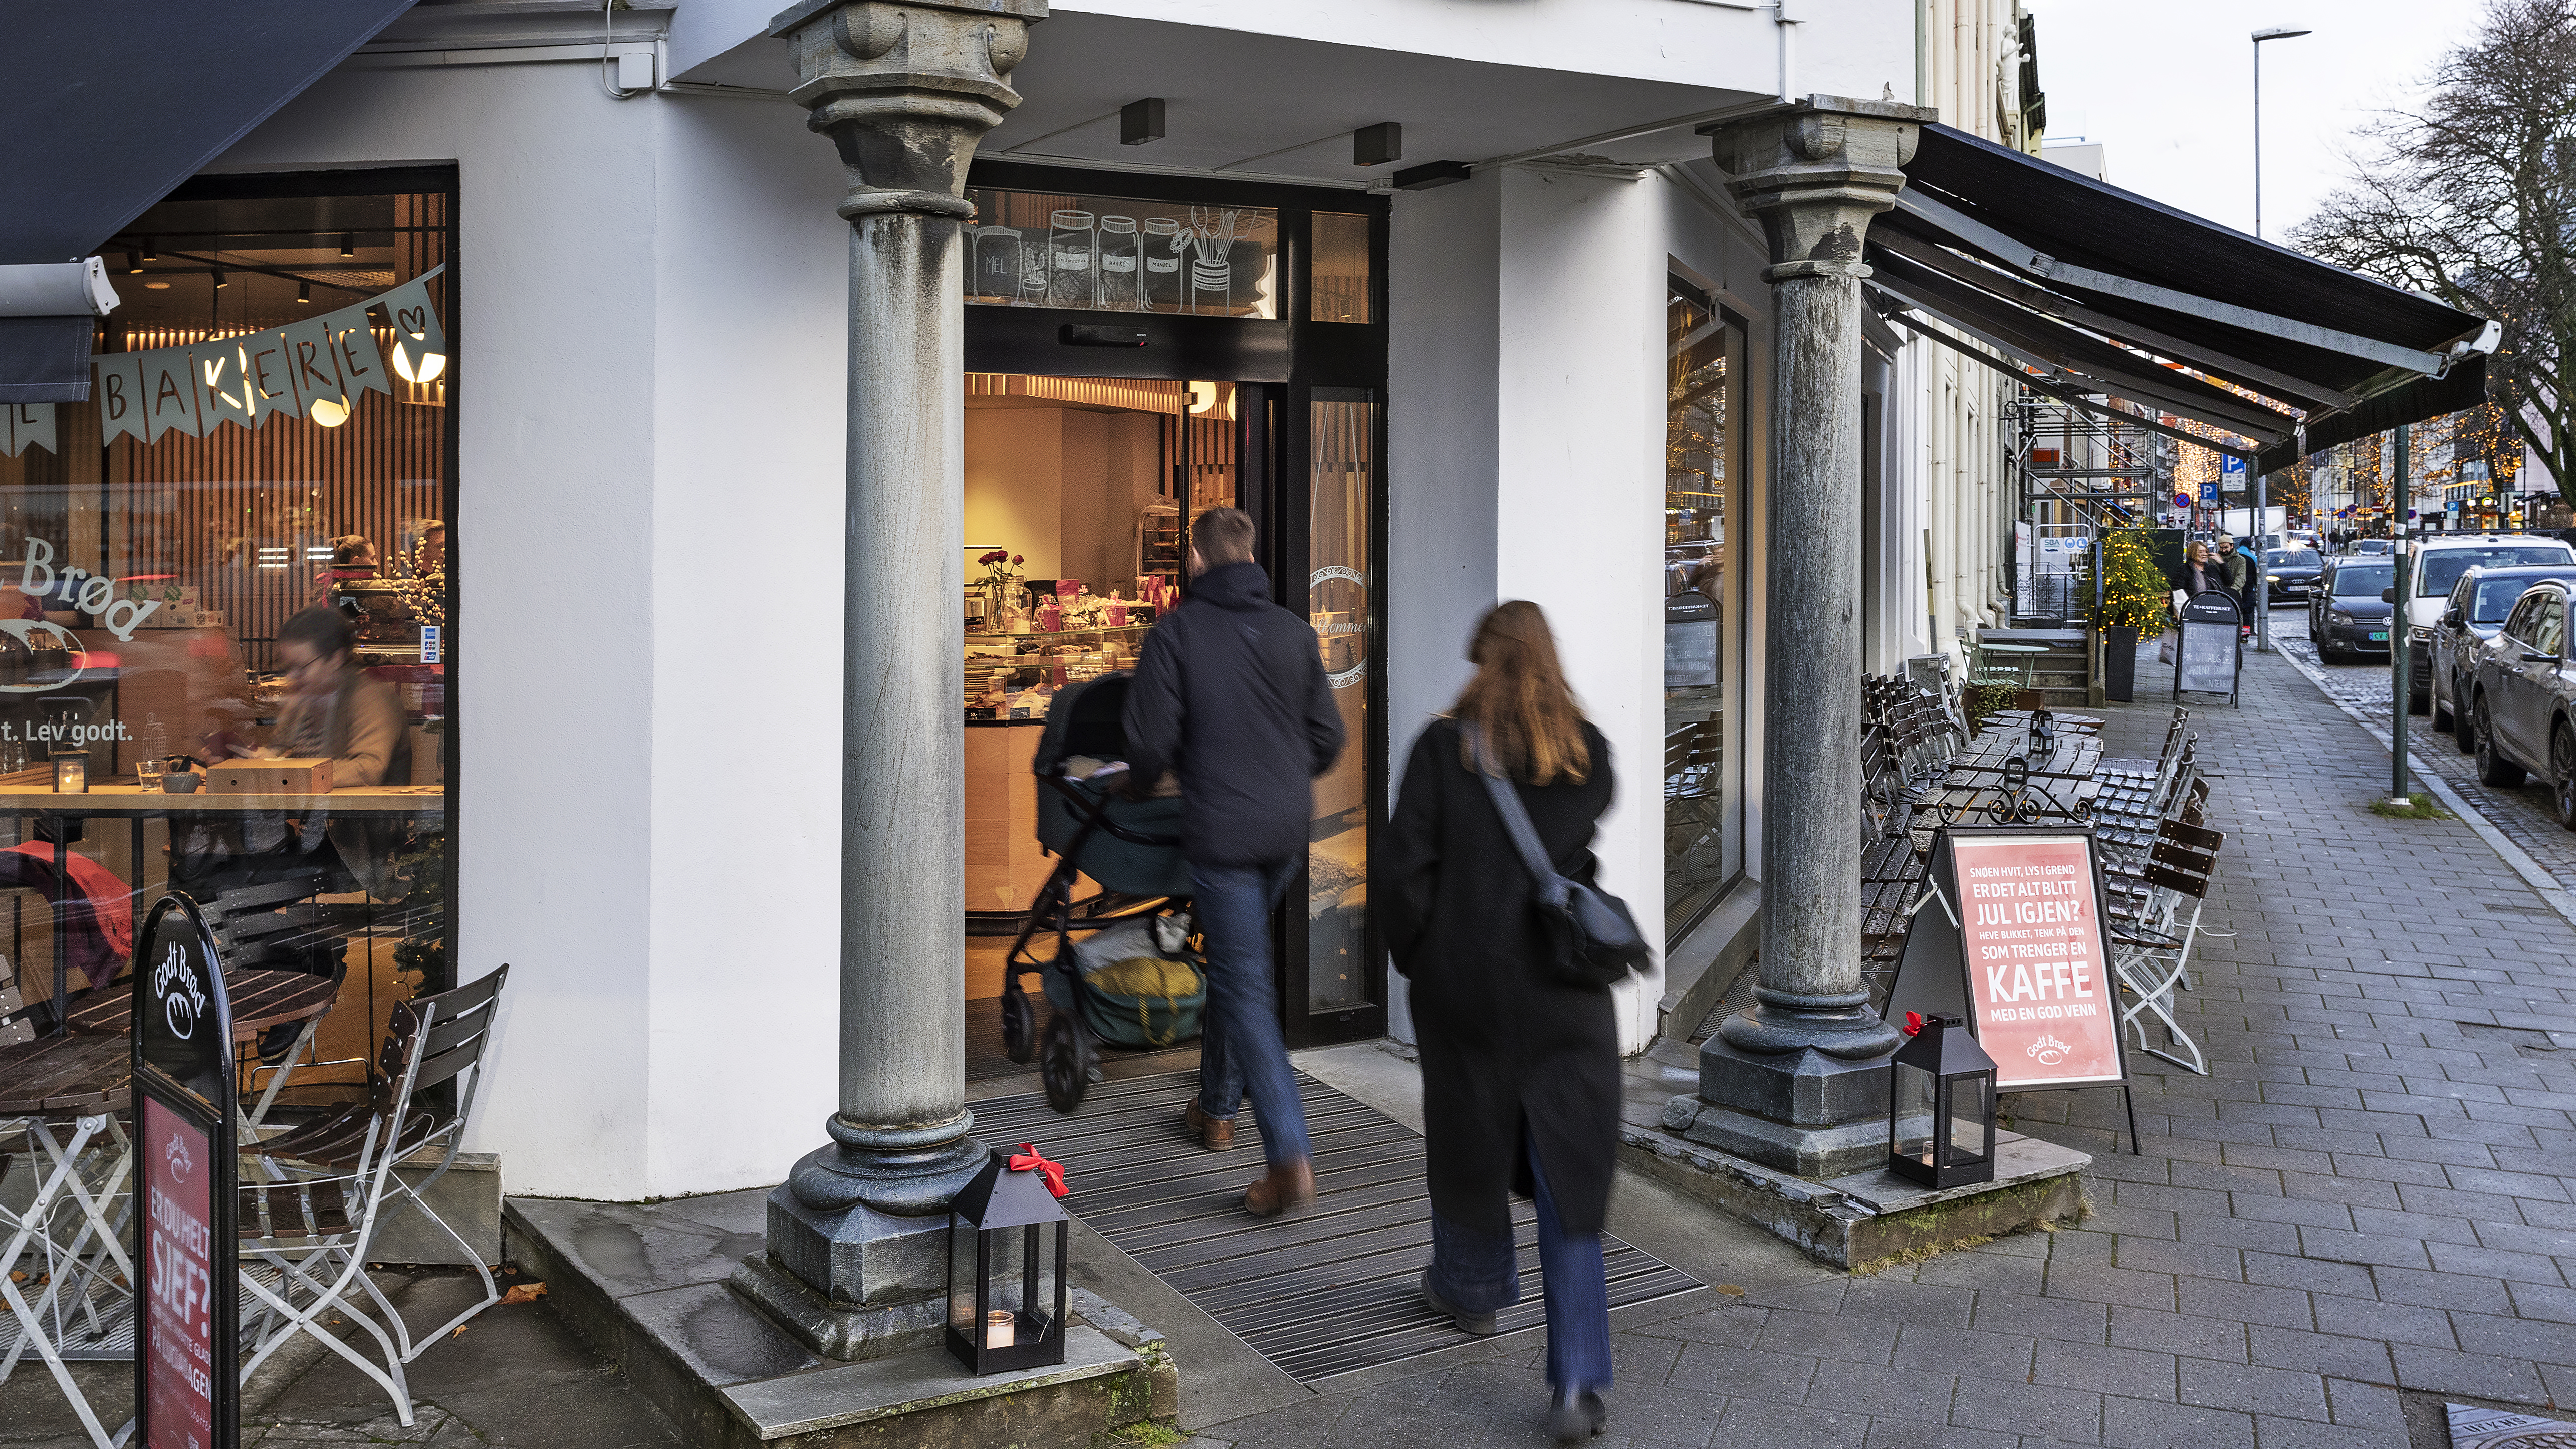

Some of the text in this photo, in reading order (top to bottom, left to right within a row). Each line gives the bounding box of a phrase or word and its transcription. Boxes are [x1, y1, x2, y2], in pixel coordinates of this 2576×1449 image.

[986, 255, 1007, 275] MEL
[107, 327, 369, 420] BAKERE
[2204, 486, 2213, 498] P
[18, 536, 163, 642] Brød
[26, 720, 64, 741] Lev
[72, 719, 133, 747] godt.
[1970, 865, 2075, 878] SNØEN HVIT, LYS I GREND
[1973, 880, 2077, 898] ER DET ALT BLITT
[1977, 900, 2080, 926] JUL IGJEN?
[1979, 925, 2085, 940] HEVE BLIKKET, TENK PÅ DEN
[1981, 941, 2087, 960] SOM TRENGER EN
[155, 940, 206, 1018] Godt Brød
[1986, 961, 2093, 1003] KAFFE
[1991, 1003, 2097, 1022] MED EN GOD VENN
[2026, 1034, 2072, 1058] Godt Brød
[151, 1185, 163, 1226] ER
[164, 1197, 180, 1238] DU
[151, 1229, 211, 1338] SJEF?
